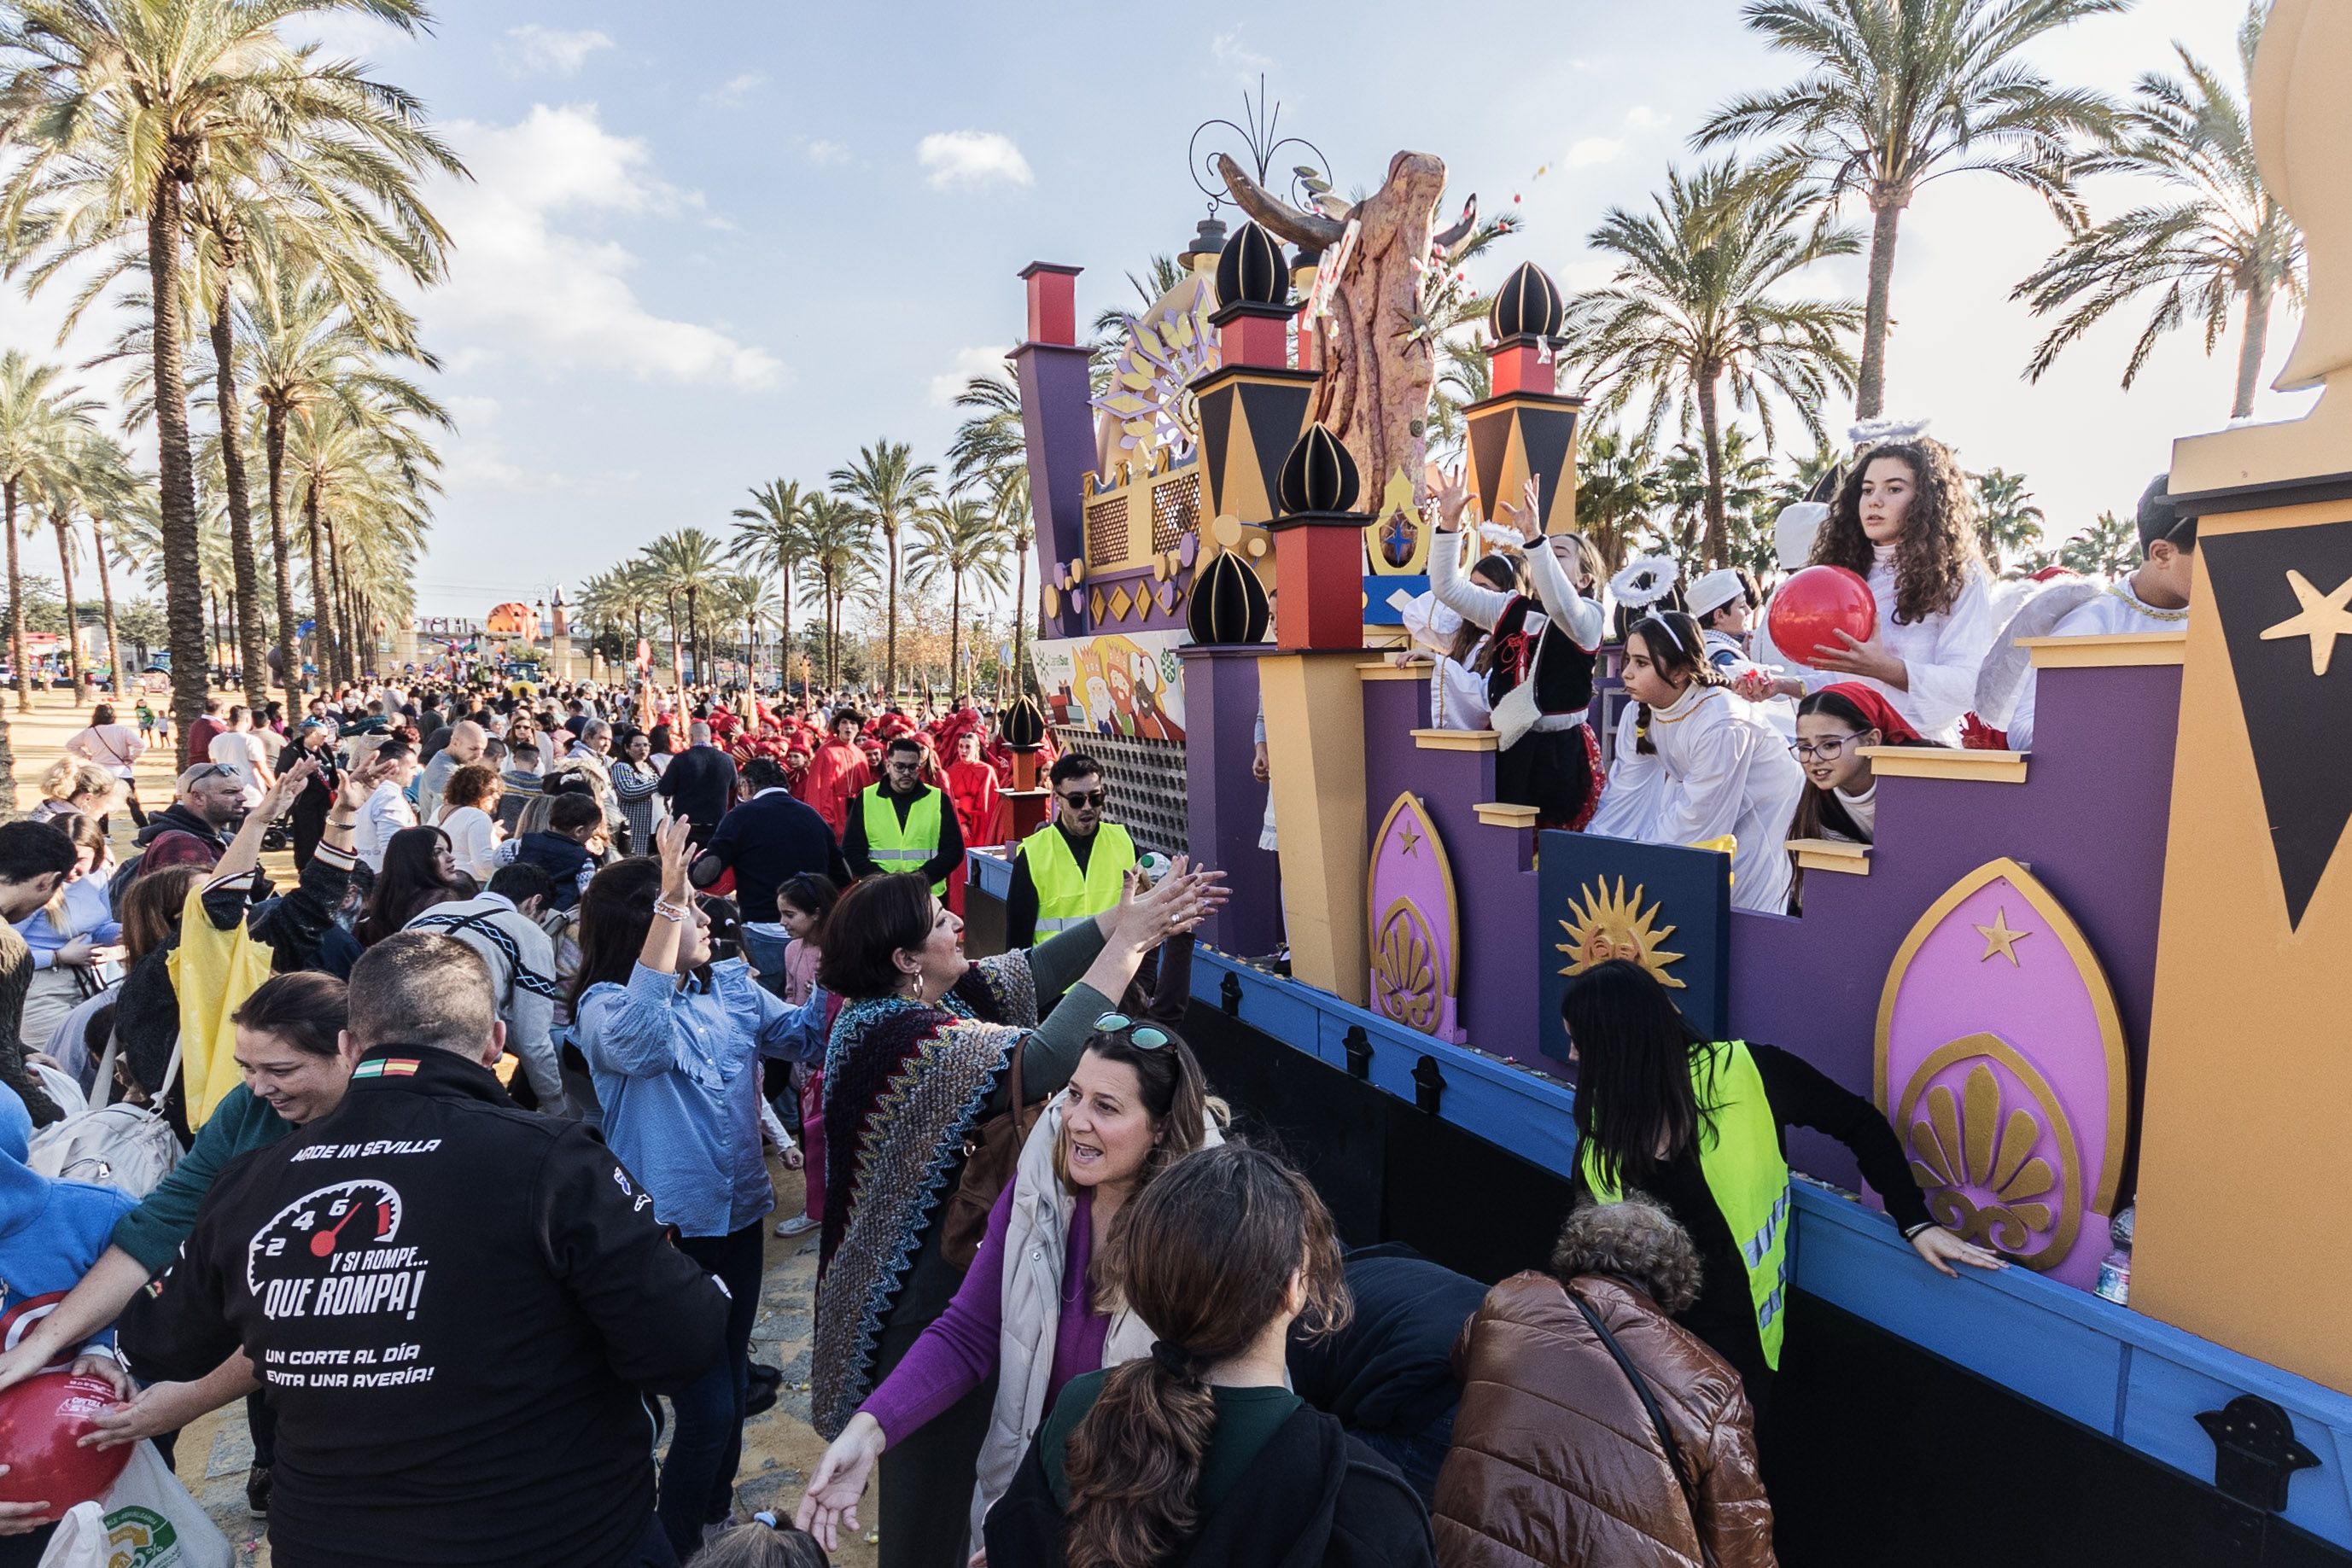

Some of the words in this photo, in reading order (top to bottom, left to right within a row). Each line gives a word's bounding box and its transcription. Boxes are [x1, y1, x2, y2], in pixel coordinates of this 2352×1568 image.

[290, 1145, 339, 1162] MADE
[336, 1144, 362, 1158] IN
[360, 1140, 441, 1157] SEVILLA
[328, 1198, 350, 1215] 6
[291, 1210, 316, 1231] 4
[266, 1238, 287, 1256] 2
[330, 1252, 341, 1273] Y
[341, 1251, 360, 1272] SI
[360, 1246, 429, 1270] ROMPE...
[264, 1278, 315, 1320] QUE
[313, 1269, 426, 1320] ROMPA!
[265, 1349, 286, 1363] UN
[289, 1349, 351, 1365] CORTE
[353, 1349, 377, 1365] AL
[382, 1343, 421, 1363] DÍA
[266, 1370, 306, 1387] EVITA
[310, 1373, 349, 1388] UNA
[353, 1367, 435, 1388] AVERÍA!
